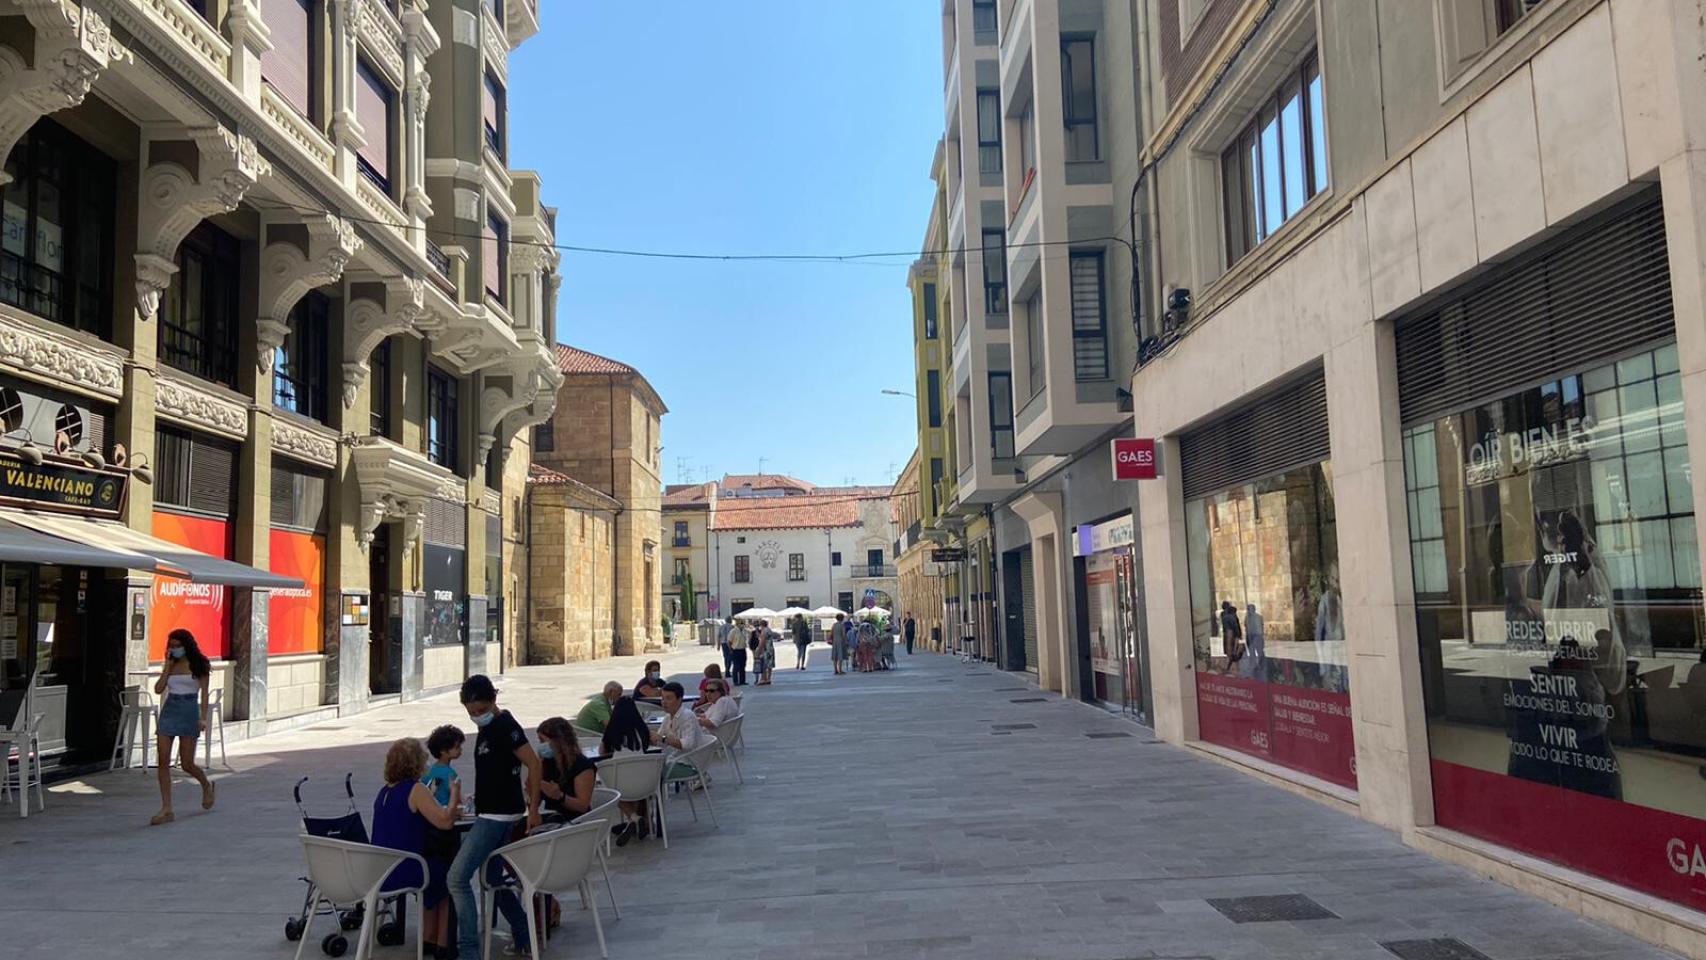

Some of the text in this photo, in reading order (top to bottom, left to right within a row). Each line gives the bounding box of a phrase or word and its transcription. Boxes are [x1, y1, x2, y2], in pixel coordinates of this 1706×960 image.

[1117, 450, 1153, 463] GAES
[1470, 431, 1504, 467] OÍR
[1510, 423, 1559, 465] BIEN
[7, 469, 94, 497] VALENCIANO
[160, 579, 210, 597] AUDÍFONOS
[434, 590, 452, 601] TIGER
[1506, 620, 1599, 647] REDESCUBRIR
[1530, 673, 1578, 697] SENTIR
[1503, 692, 1615, 720] EMOCIONES DEL SONIDO
[1539, 723, 1578, 749] VIVIR
[1509, 740, 1619, 773] TODO LO QUE TE RODEA
